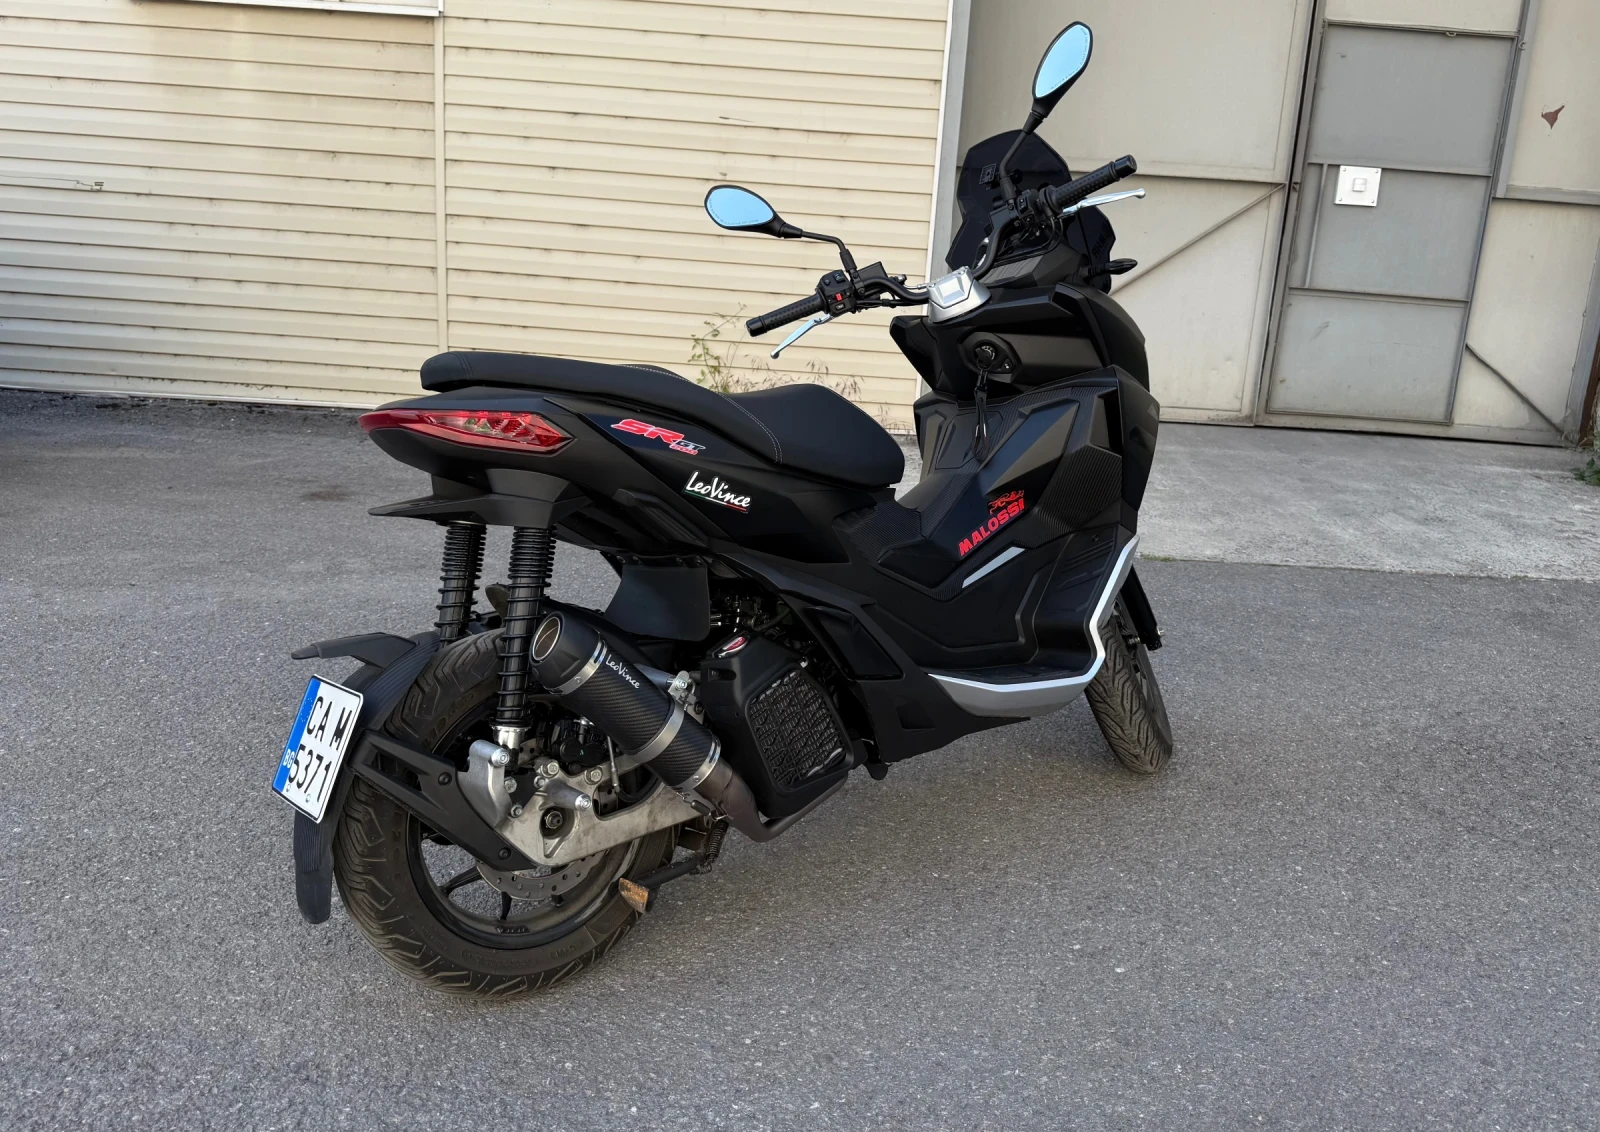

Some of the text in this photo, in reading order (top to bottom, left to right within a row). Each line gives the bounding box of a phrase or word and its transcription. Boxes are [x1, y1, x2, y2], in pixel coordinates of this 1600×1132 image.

[611, 419, 685, 444] SR
[686, 471, 751, 508] LeoVince
[958, 498, 1025, 557] MALOSSI
[605, 653, 640, 689] LeoVince
[306, 696, 352, 751] CA M
[283, 748, 295, 769] BG
[288, 744, 332, 803] 5371
